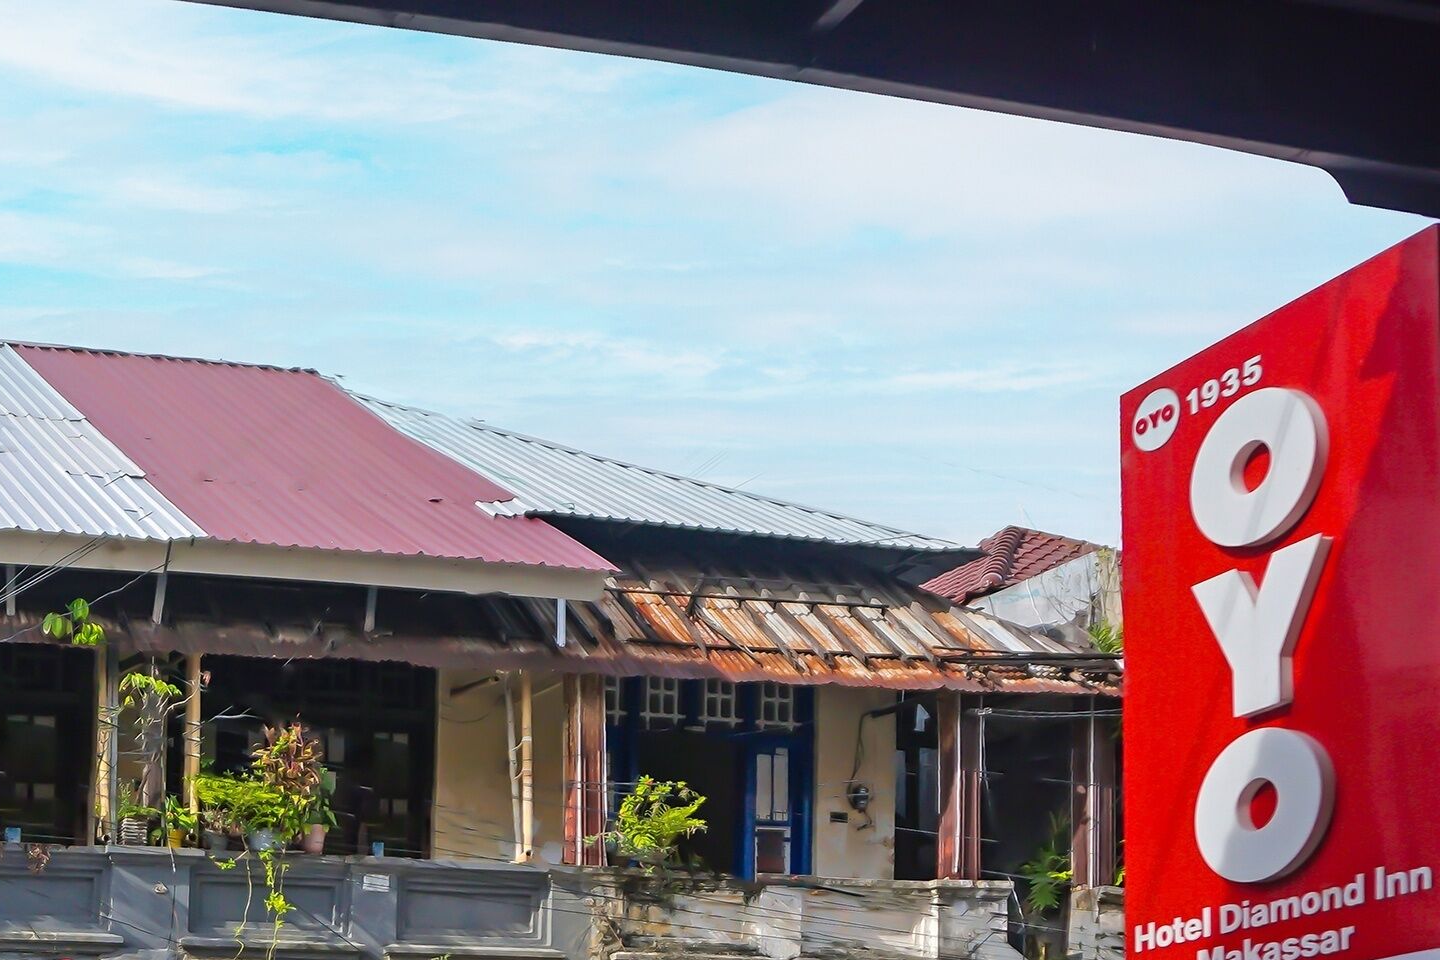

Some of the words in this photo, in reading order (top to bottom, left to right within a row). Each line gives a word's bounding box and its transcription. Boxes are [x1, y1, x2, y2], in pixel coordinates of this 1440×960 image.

[1135, 403, 1175, 436] OYO
[1185, 354, 1263, 416] 1935
[1190, 386, 1335, 883] OYO
[1134, 906, 1211, 953] Hotel
[1219, 873, 1365, 934] Diamond
[1374, 865, 1433, 900] Inn
